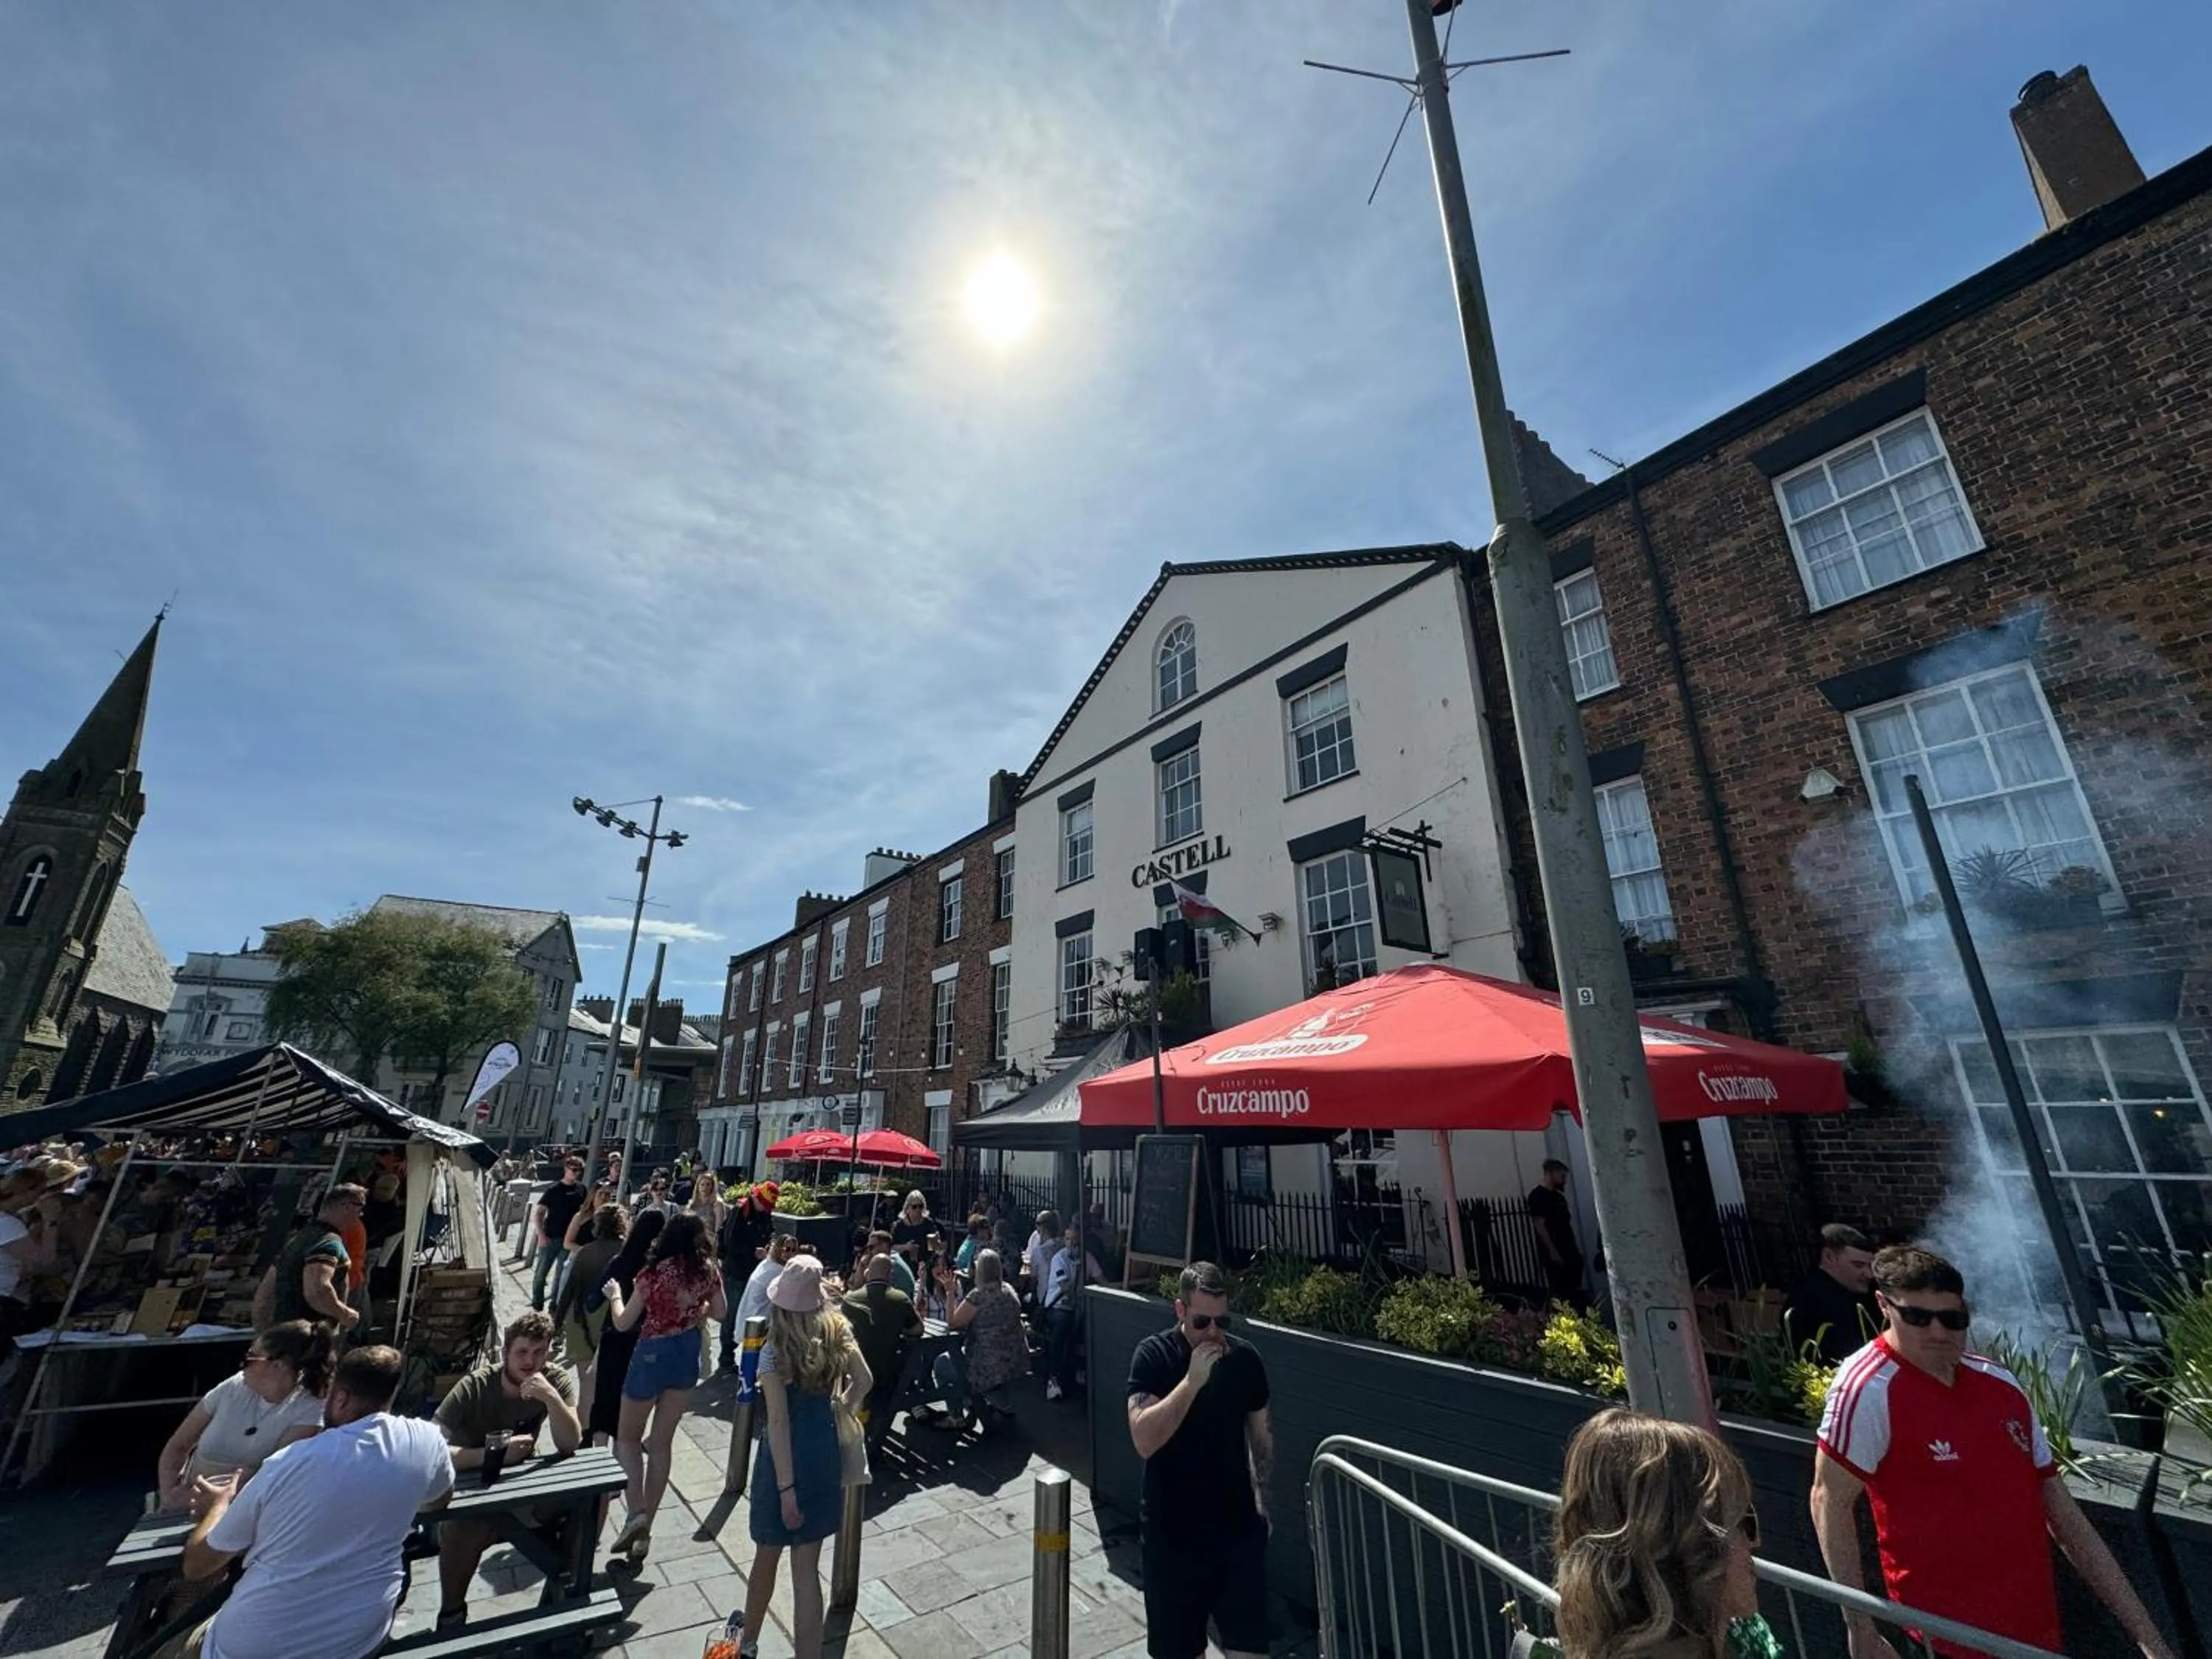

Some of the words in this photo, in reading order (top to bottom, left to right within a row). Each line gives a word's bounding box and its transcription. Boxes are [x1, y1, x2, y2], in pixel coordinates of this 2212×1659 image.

[1132, 835, 1231, 888] CASTELL
[1581, 990, 1590, 1003] 9
[1197, 1086, 1310, 1118] Cruzcampo
[1698, 1069, 1778, 1105] Cruzcampo
